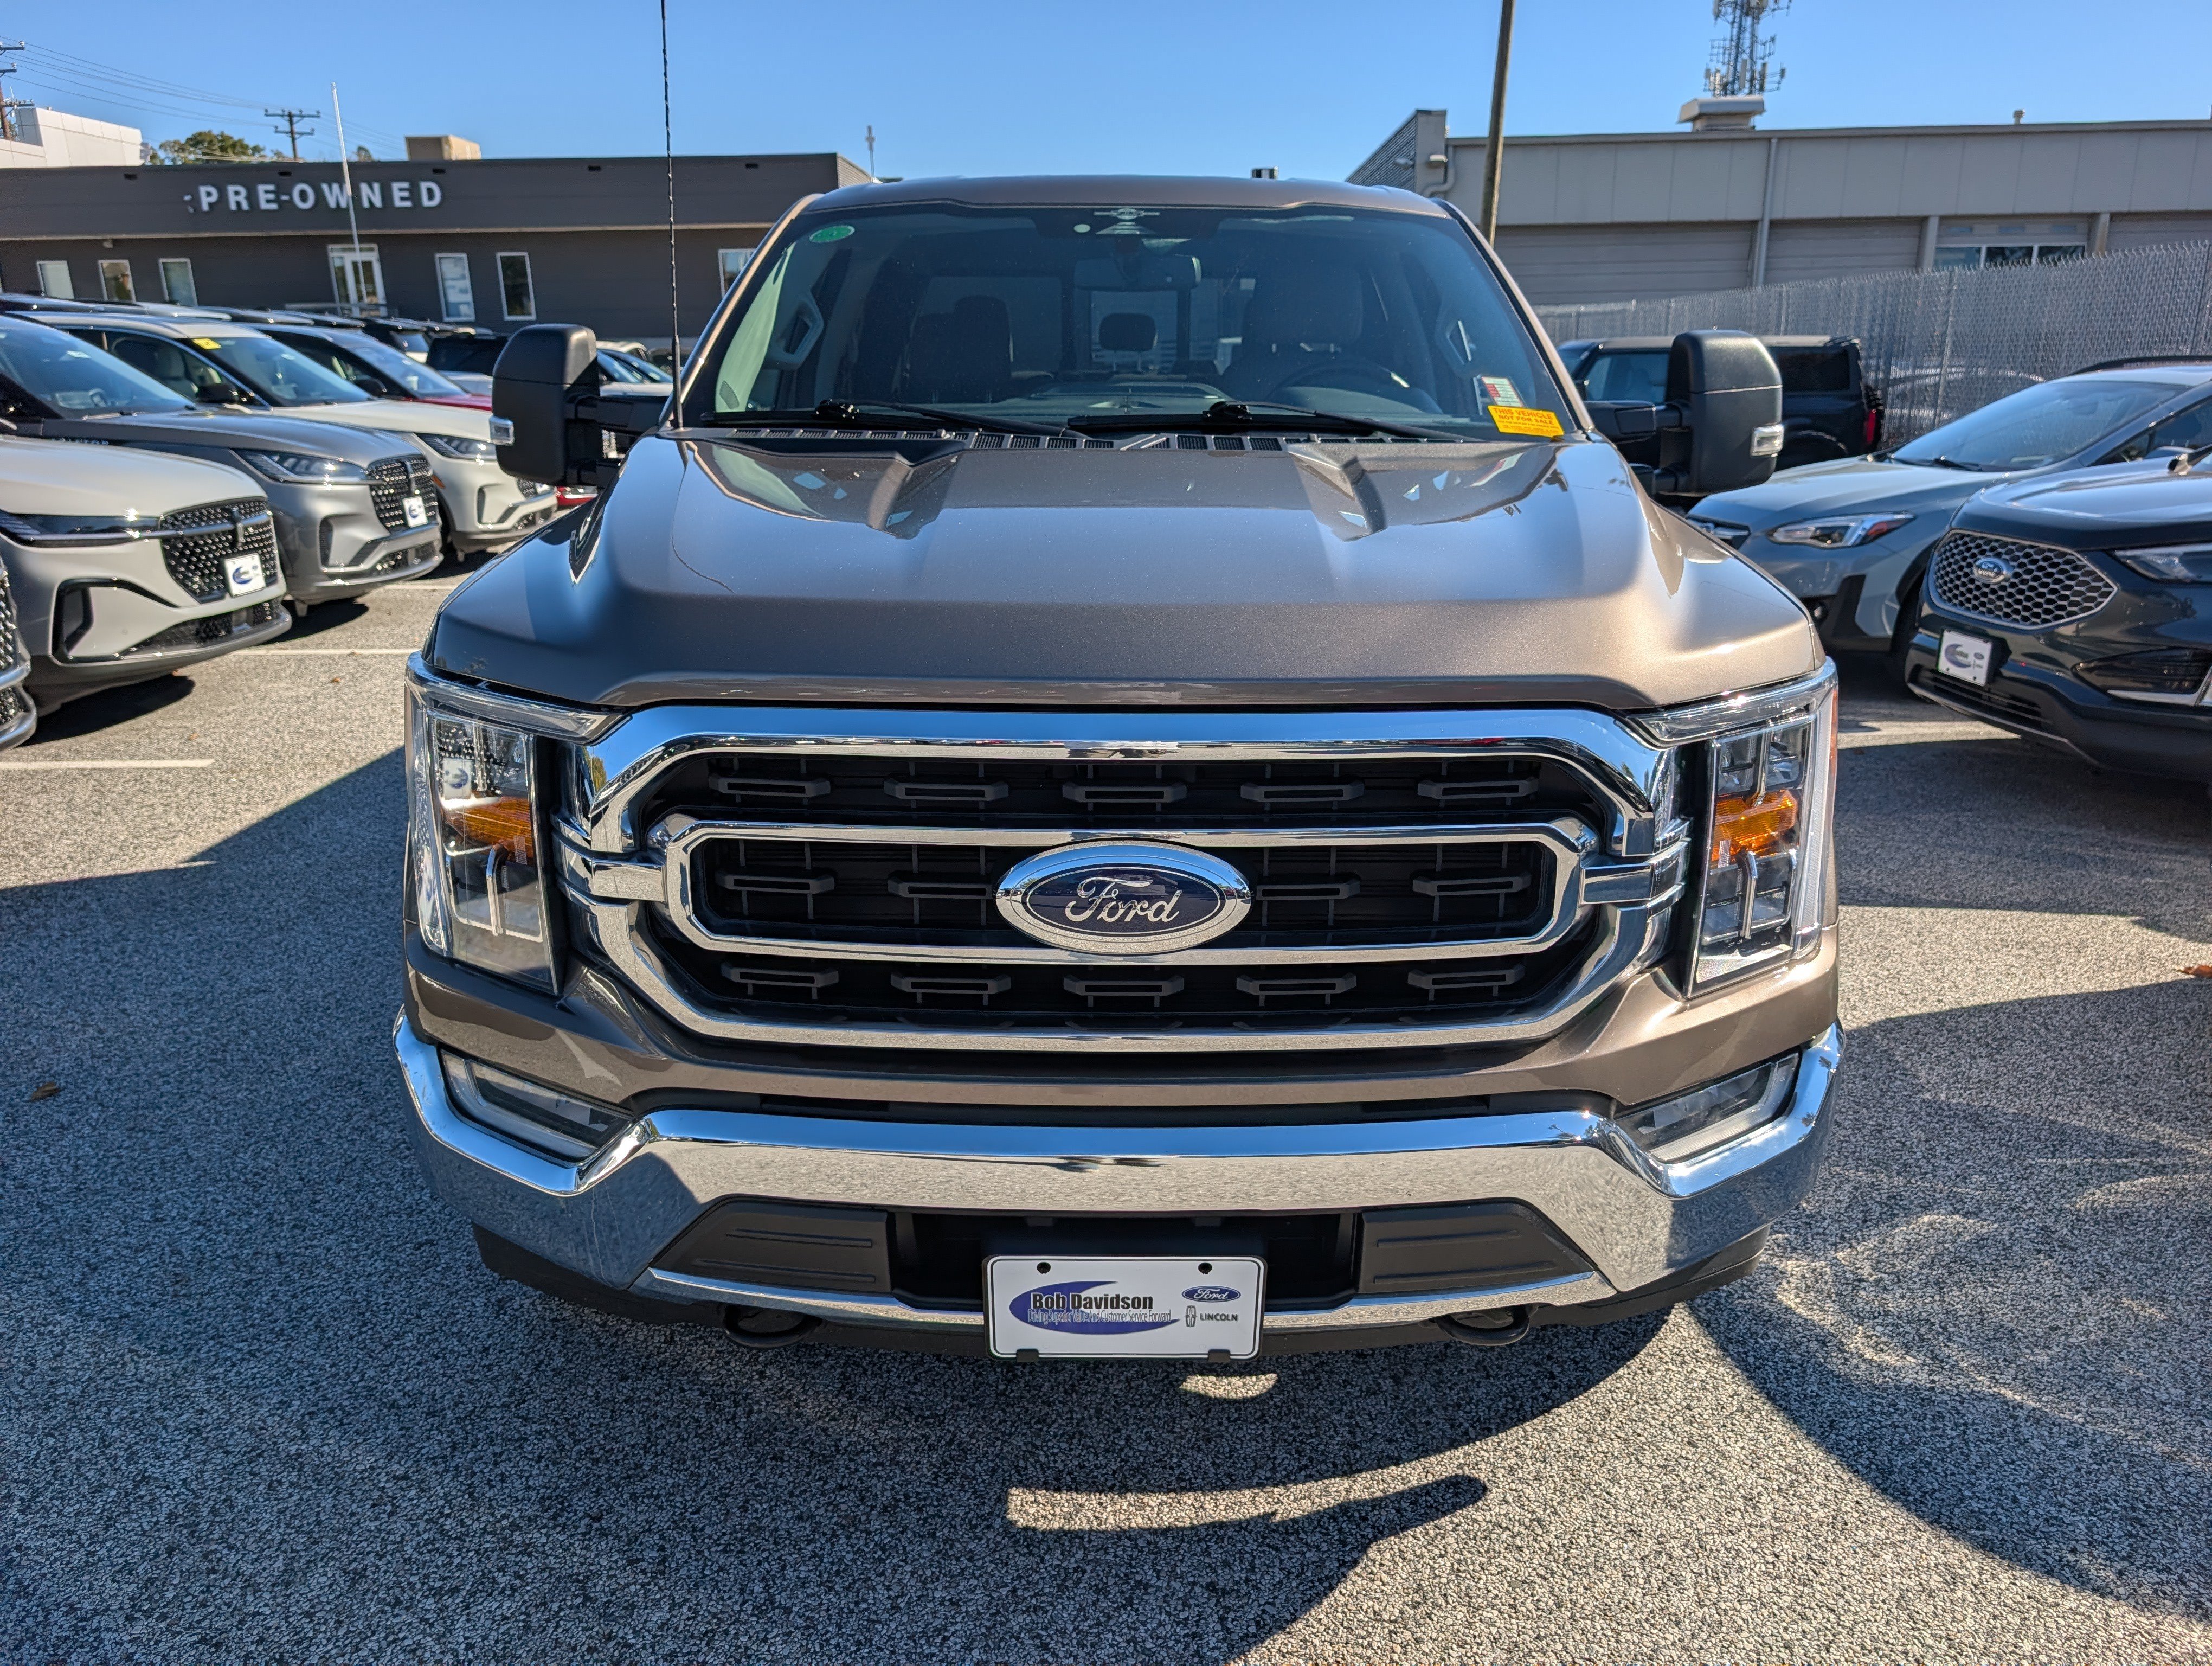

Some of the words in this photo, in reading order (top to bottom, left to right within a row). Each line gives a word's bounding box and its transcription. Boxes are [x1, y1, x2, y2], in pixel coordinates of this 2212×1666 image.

[198, 181, 442, 212] PRE-OWNED
[1515, 410, 1553, 420] VEHICLE
[1065, 876, 1182, 922] Ford
[1031, 1292, 1067, 1310] Bob
[1070, 1293, 1153, 1310] Davidson
[1193, 1288, 1229, 1299] Ford
[1028, 1309, 1049, 1325] Driving
[1049, 1309, 1072, 1325] Superior
[1072, 1309, 1089, 1322] Value
[1089, 1310, 1100, 1322] And
[1101, 1310, 1128, 1322] Customer
[1128, 1310, 1148, 1322] Service
[1149, 1309, 1171, 1322] Forward
[1200, 1313, 1238, 1321] LINCOLN
